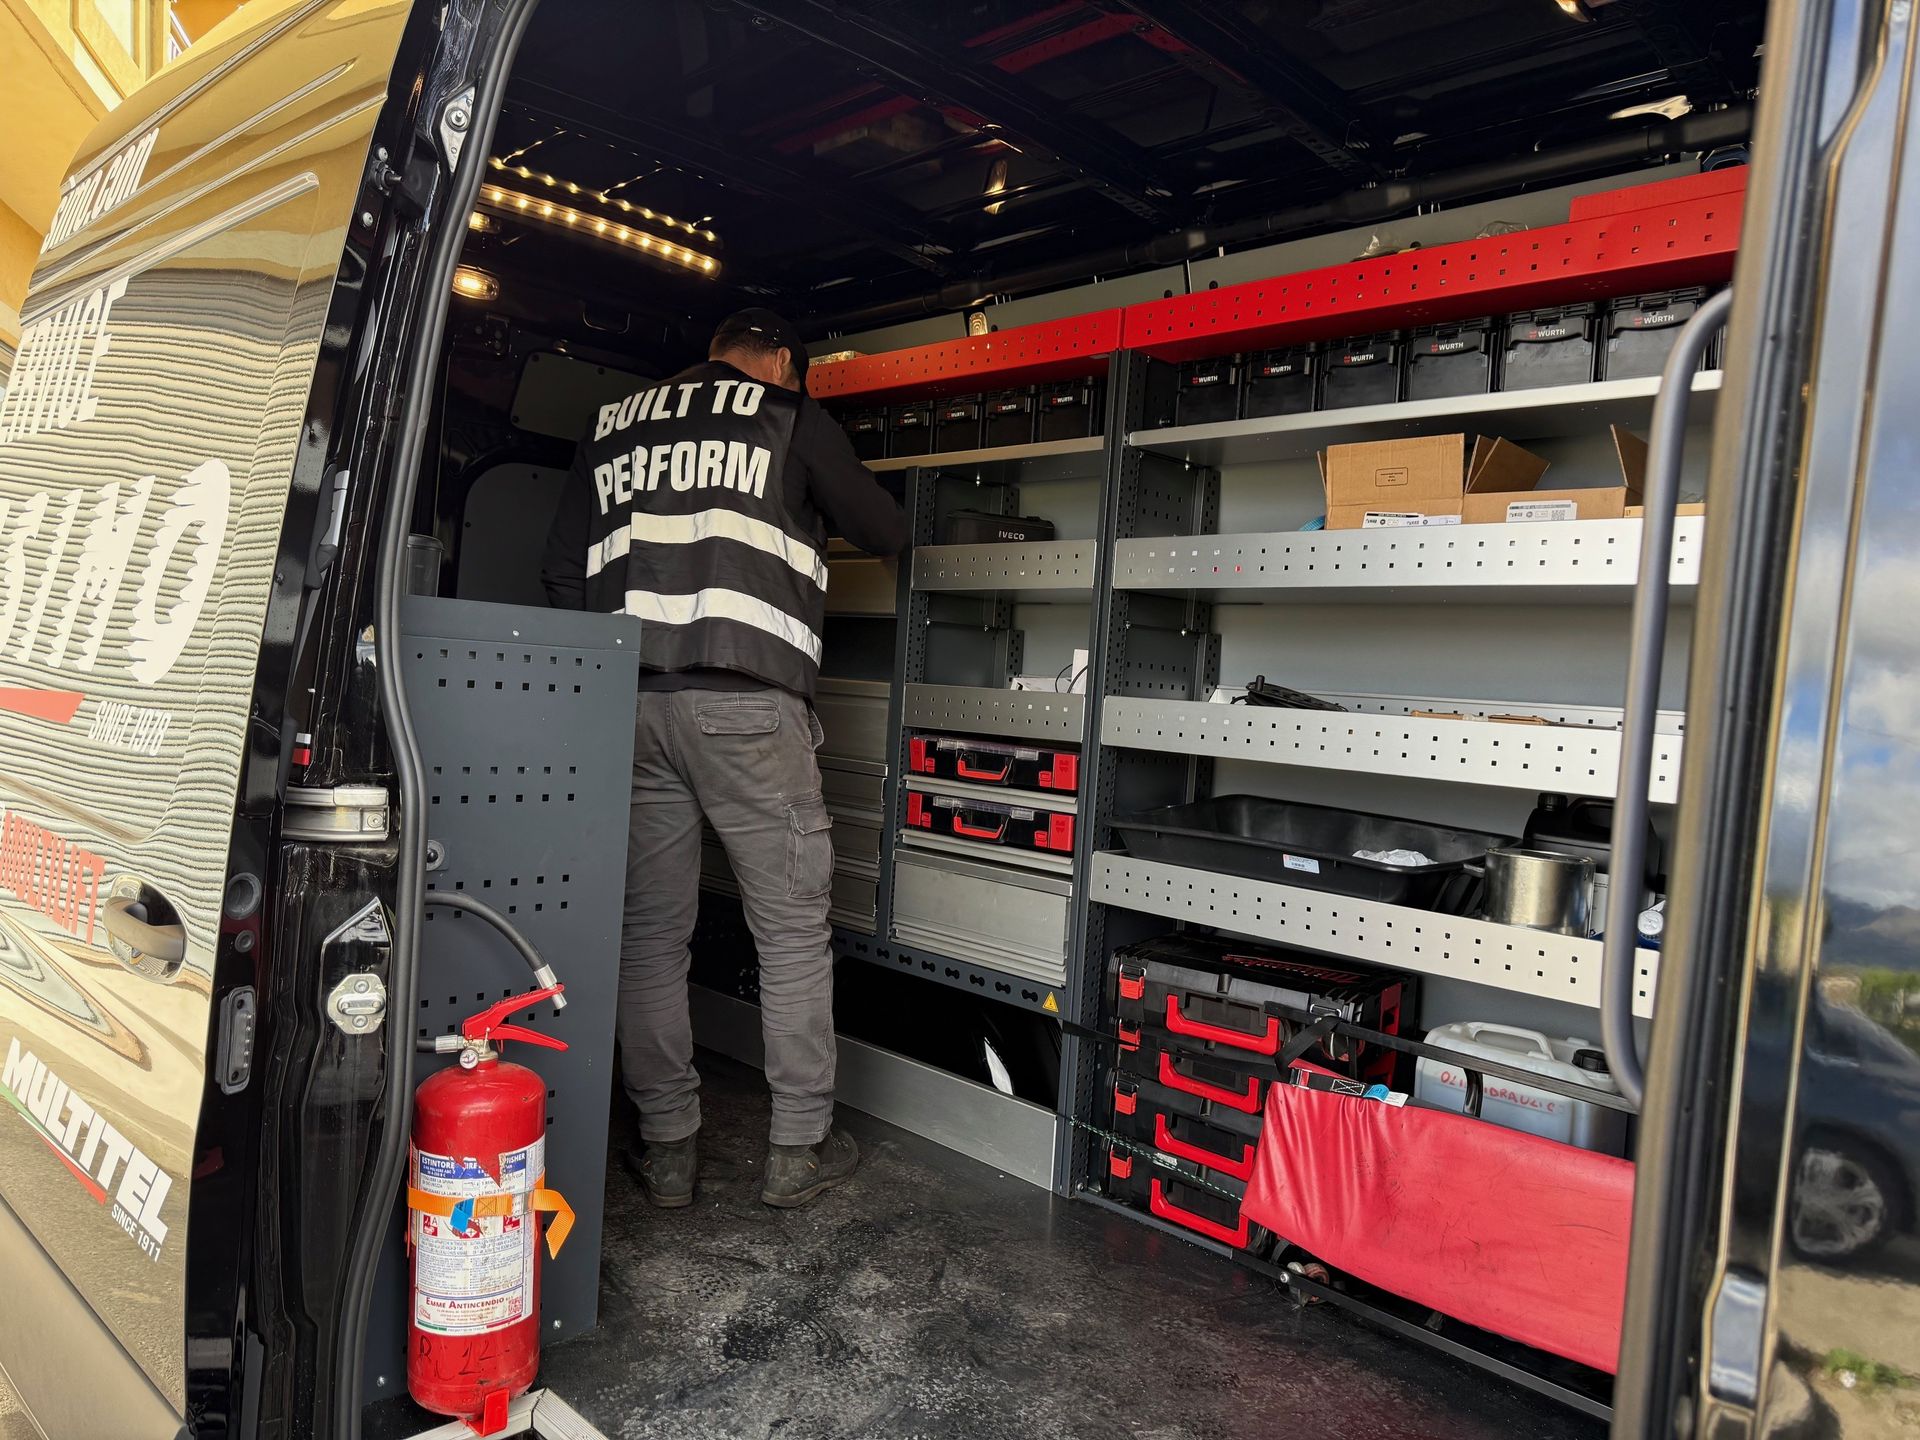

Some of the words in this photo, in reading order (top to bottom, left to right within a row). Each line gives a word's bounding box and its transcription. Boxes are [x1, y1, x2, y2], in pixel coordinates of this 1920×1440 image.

[594, 382, 703, 442] BUILT
[711, 380, 765, 416] TO
[594, 440, 771, 515] PERFORM
[998, 530, 1025, 540] IVECO
[88, 700, 137, 746] SINCE
[1, 1036, 173, 1245] MULTITEL
[422, 1156, 455, 1169] ESTINTORE
[111, 1204, 137, 1239] SINCE
[137, 1229, 161, 1262] 1911
[448, 1296, 504, 1309] ANTINCENDIO
